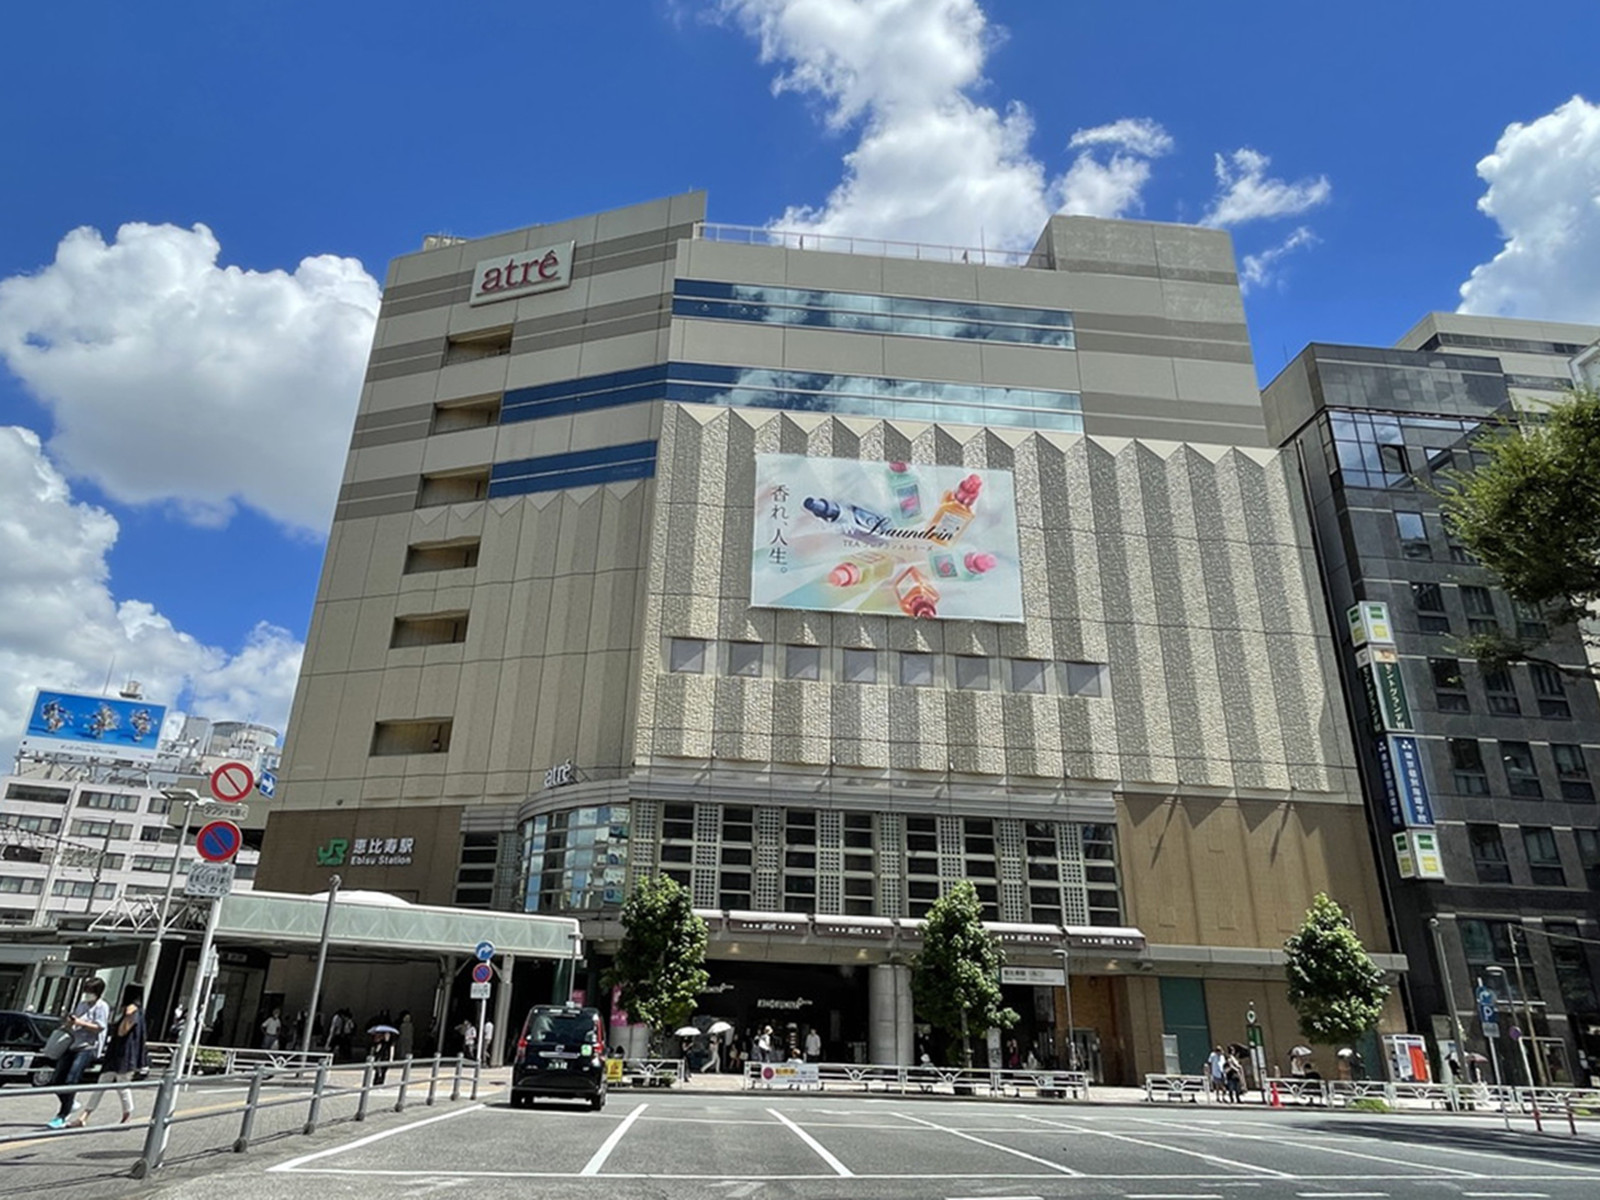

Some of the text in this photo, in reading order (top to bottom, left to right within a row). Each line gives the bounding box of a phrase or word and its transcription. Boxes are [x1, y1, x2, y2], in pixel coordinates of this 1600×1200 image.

[769, 484, 790, 573] 香れ、人生。
[317, 838, 348, 865] JR
[353, 837, 414, 854] 恵比寿駅
[350, 856, 412, 865] Ebisu Station
[1483, 1006, 1493, 1020] P
